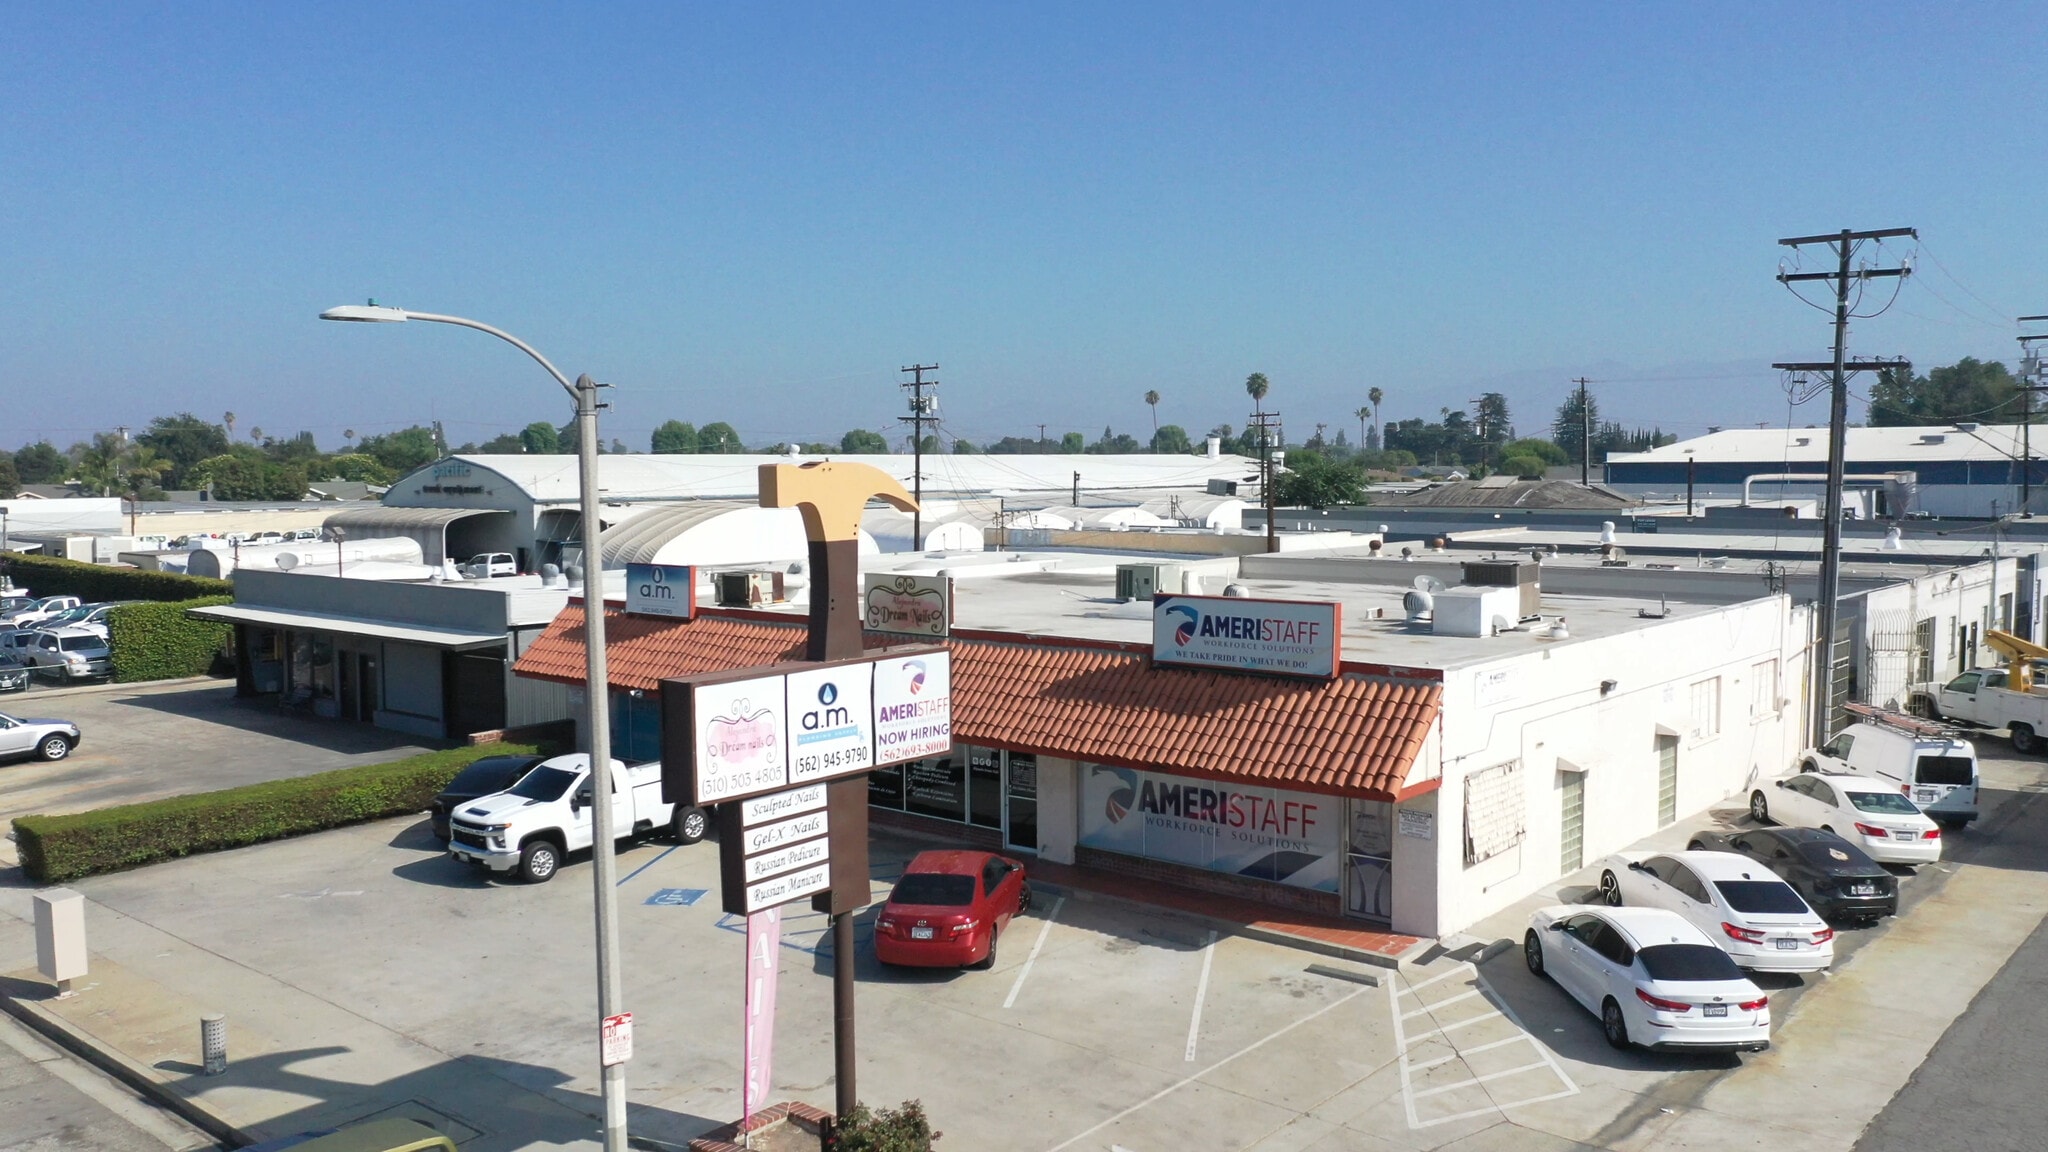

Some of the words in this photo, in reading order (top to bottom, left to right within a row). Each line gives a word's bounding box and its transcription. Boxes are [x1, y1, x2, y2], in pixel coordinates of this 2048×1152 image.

[640, 584, 675, 599] a.m.
[881, 606, 908, 623] Dream
[910, 607, 931, 627] Nails
[1200, 614, 1320, 645] AMERISTAFF
[1176, 650, 1187, 658] WE
[1190, 651, 1211, 661] TAKE
[1212, 653, 1237, 663] PRIDE
[1238, 655, 1248, 663] IN
[1250, 656, 1274, 666] WHAT
[1277, 658, 1290, 668] WE
[1292, 660, 1308, 669] DO!
[1203, 639, 1257, 651] WORKFORCE
[1262, 644, 1315, 655] SOLUTIONS
[802, 707, 853, 730] a.m.
[879, 697, 949, 723] AMERISTAFF
[879, 730, 907, 746] NOW
[911, 723, 949, 741] HIRING
[721, 741, 746, 757] Dream
[795, 755, 820, 776] (562)
[823, 746, 867, 768] 945-9790
[755, 766, 782, 783] 4805
[752, 793, 794, 817] Sculpted
[794, 787, 819, 806] Nails
[1138, 780, 1318, 838] AMERISTAFF
[753, 826, 786, 851] Gel-X
[791, 816, 820, 837] Nails
[1145, 817, 1221, 837] WORKFORCE
[1232, 830, 1310, 852] SOLUTIONS
[754, 855, 786, 875] Russian
[788, 845, 821, 864] Pedicure
[754, 883, 786, 903] Russian
[788, 872, 823, 893] Manicure
